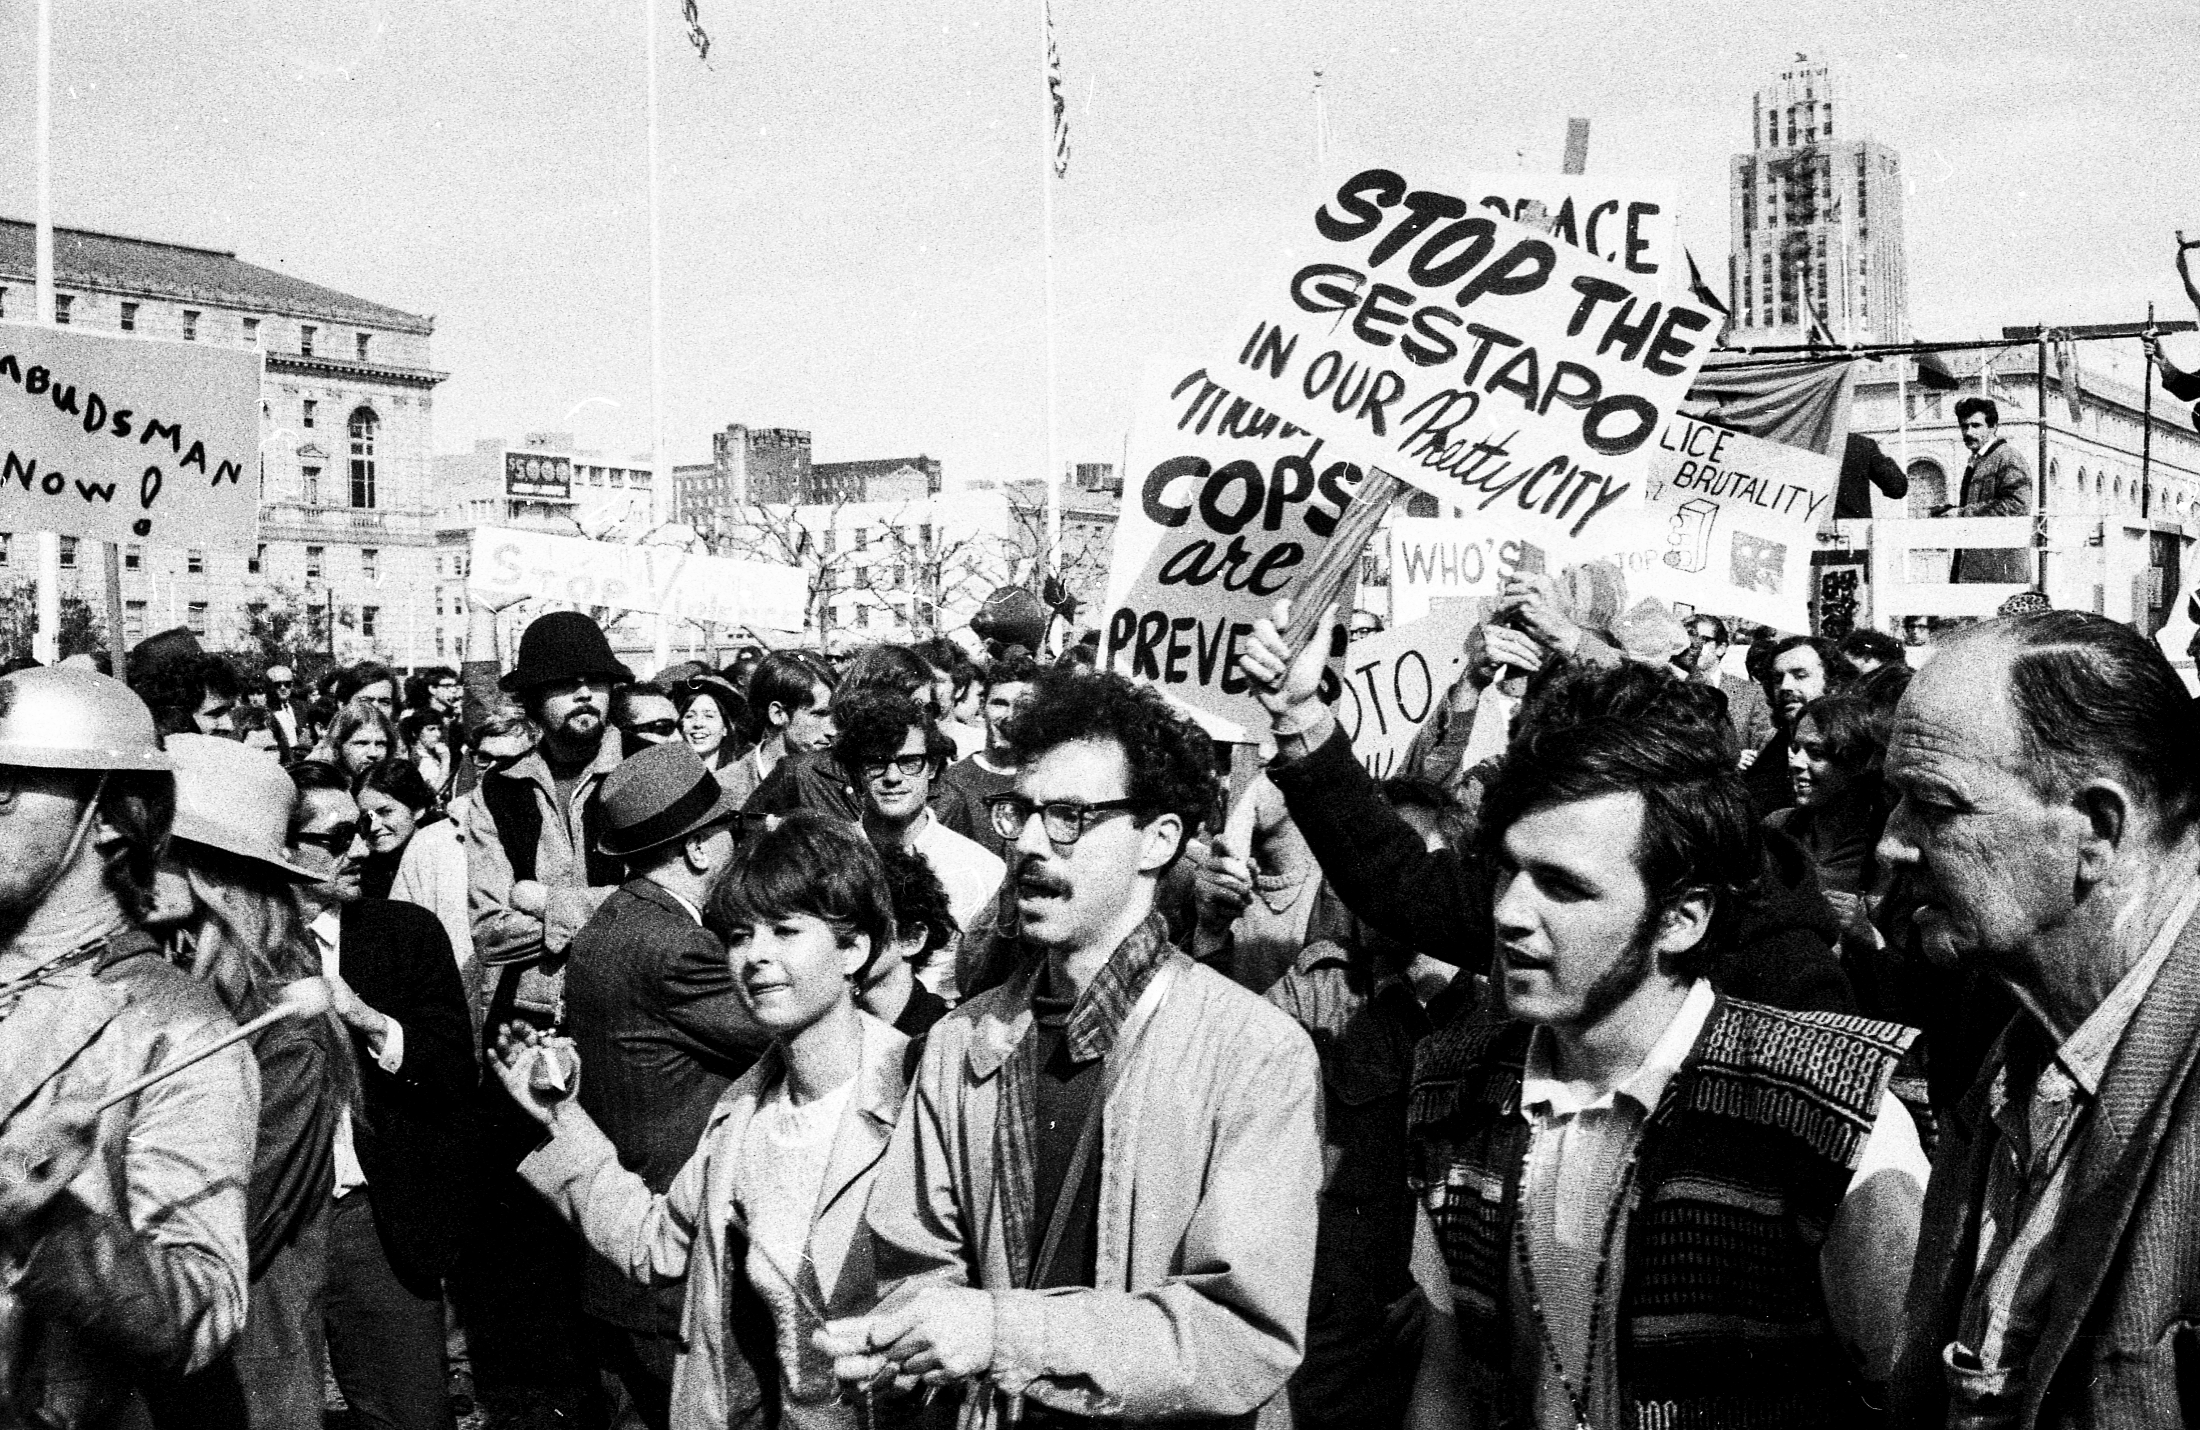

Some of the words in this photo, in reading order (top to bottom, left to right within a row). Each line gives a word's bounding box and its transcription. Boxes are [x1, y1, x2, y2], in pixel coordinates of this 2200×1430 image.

[1480, 195, 1660, 275] ACE
[1315, 168, 1557, 308] STOP
[1566, 275, 1711, 377] THE
[1291, 263, 1659, 456] GESTAPO
[1238, 320, 1299, 379] IN
[1302, 350, 1405, 438] OUR
[1398, 388, 1535, 511] Pretty
[1517, 454, 1631, 538] CITY
[1659, 420, 1735, 464] LICE
[1141, 455, 1364, 538] COPS
[1672, 460, 1829, 524] BRUTALITY
[1158, 535, 1305, 597] are
[1401, 537, 1525, 586] WHO'S
[1603, 548, 1659, 574] TOP
